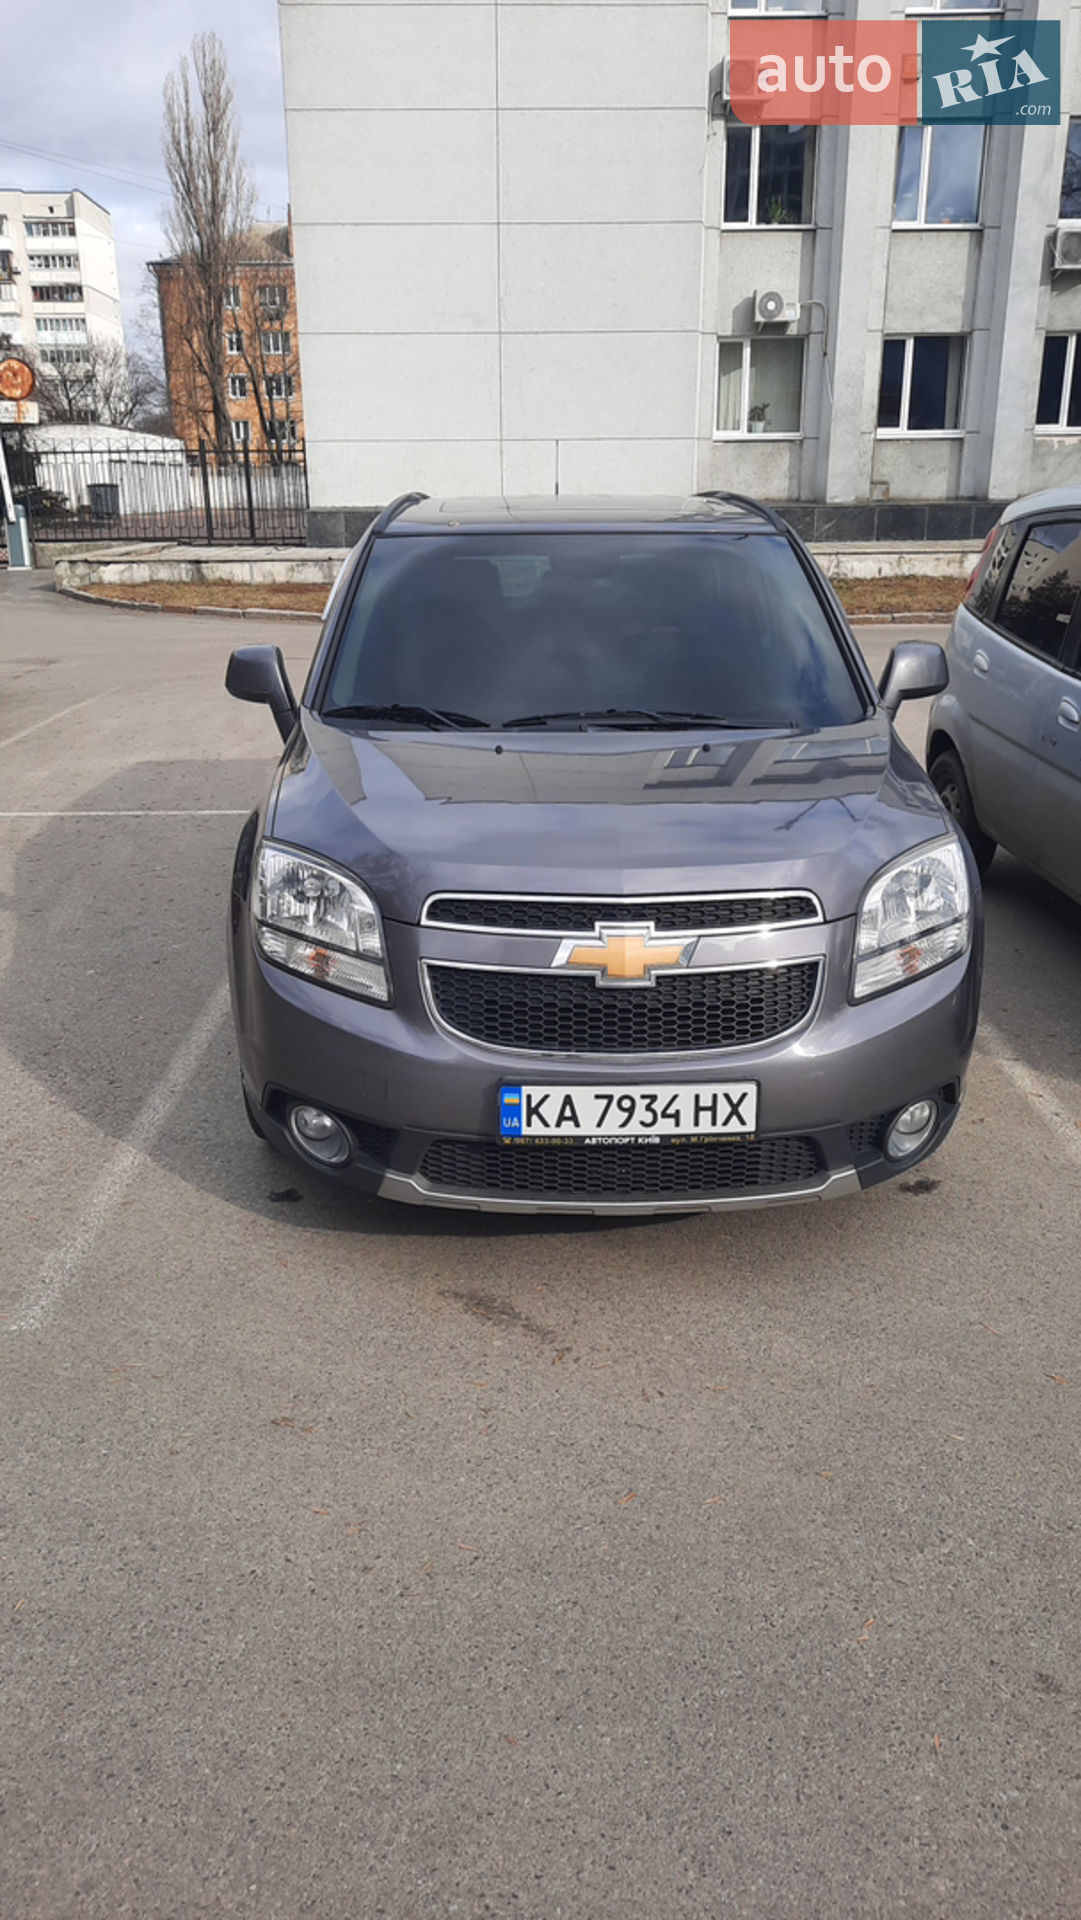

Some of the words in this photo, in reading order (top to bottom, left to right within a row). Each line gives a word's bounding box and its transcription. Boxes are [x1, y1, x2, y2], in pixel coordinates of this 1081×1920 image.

[526, 1094, 581, 1128] KA
[594, 1093, 681, 1128] 7934
[693, 1092, 748, 1127] HX
[502, 1117, 520, 1128] UA
[584, 1137, 635, 1145] АВТОПОРТ
